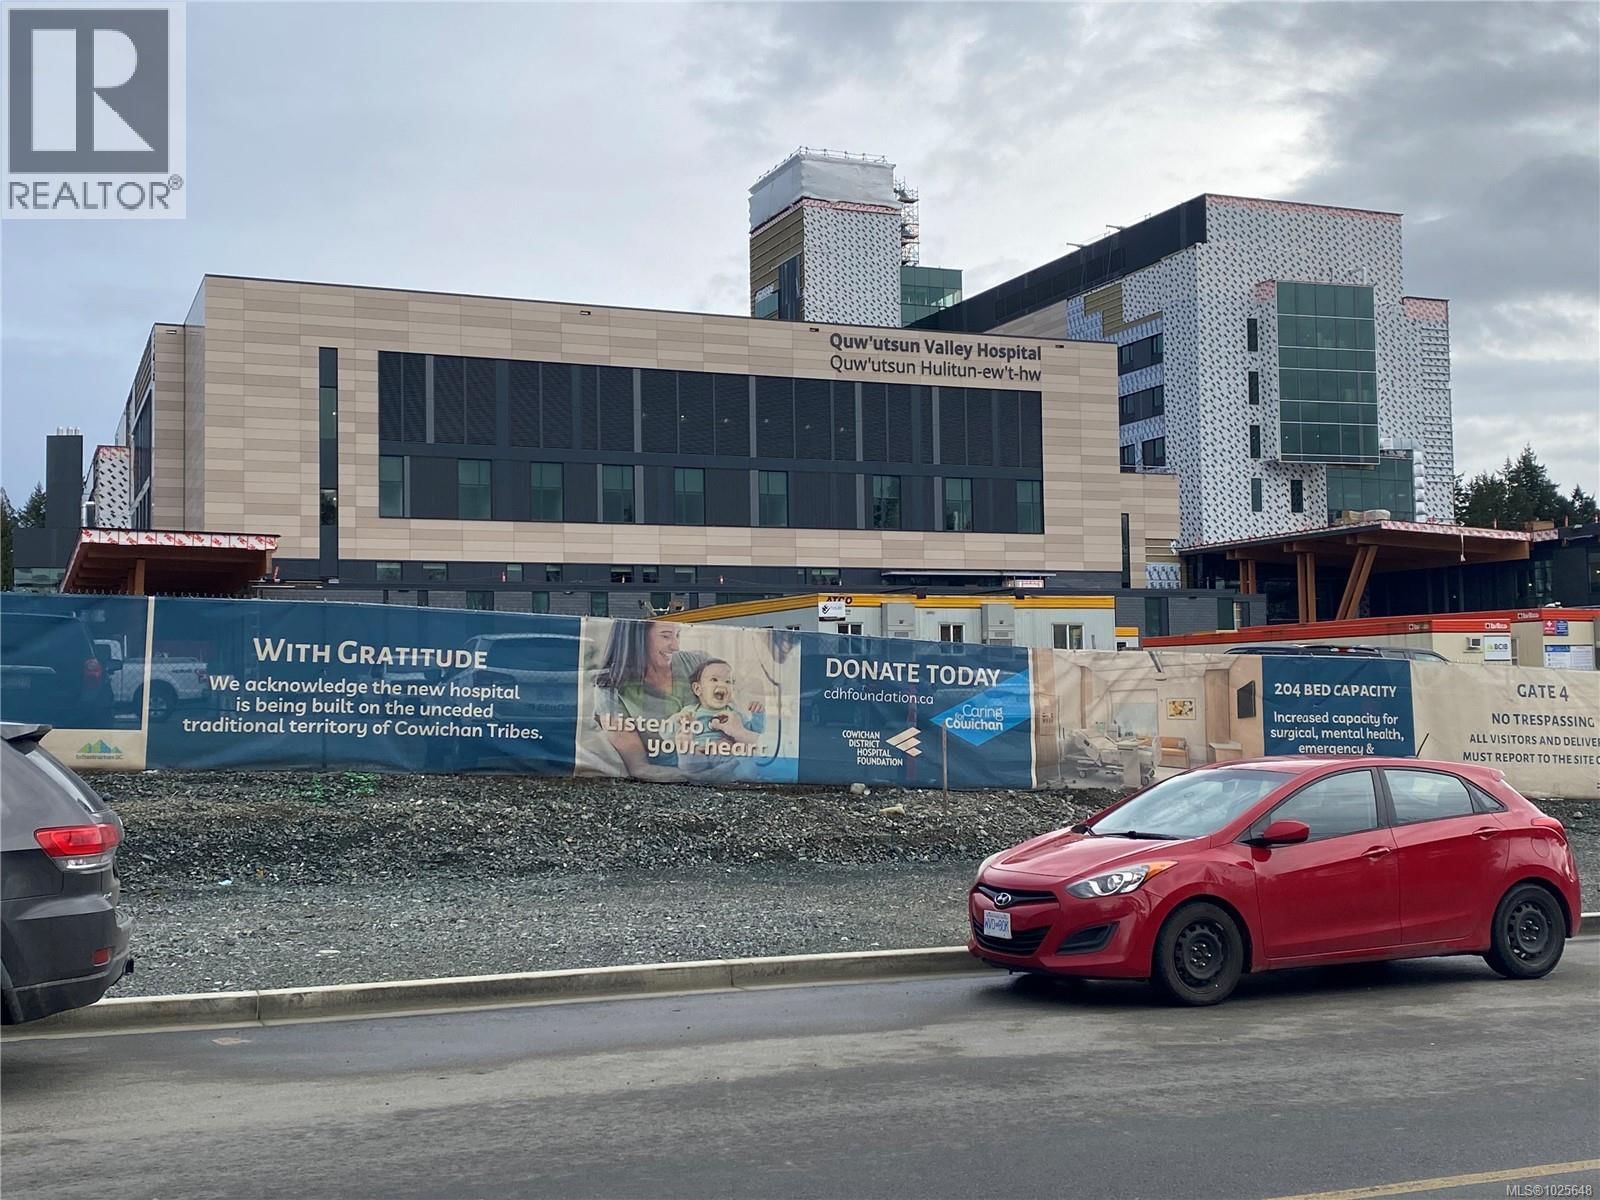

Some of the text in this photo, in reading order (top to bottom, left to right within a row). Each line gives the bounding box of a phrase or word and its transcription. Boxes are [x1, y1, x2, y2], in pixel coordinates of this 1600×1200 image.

[829, 332, 1042, 363] Quw'utsun Valley Hospital
[830, 354, 1042, 382] Quw'utsun Hulitun-ew't-hw
[825, 657, 1001, 688] DONATE TODAY
[209, 674, 520, 701] We acknowledge the new hospital
[1274, 682, 1398, 698] 204 BED CAPACITY
[1516, 684, 1569, 702] GATE 4
[823, 686, 935, 706] cdhfoundation.ca
[235, 696, 495, 719] is being built on the unceded
[962, 704, 1004, 722] Caring
[604, 712, 704, 735] Listen to
[945, 716, 1004, 732] Cowichan
[1273, 711, 1399, 727] Increased capacity for
[1491, 713, 1596, 728] NO TRESPASSING
[182, 717, 544, 740] traditional territory of Cowichan Tribes.
[842, 729, 881, 740] COWICHAN
[1270, 727, 1405, 742] surgical, mental health,
[647, 737, 769, 758] your heart
[848, 738, 881, 749] DISTRICT
[1469, 733, 1488, 744] ALL
[1490, 733, 1537, 745] VISITORS
[1539, 735, 1562, 746] AND
[856, 747, 892, 758] HOSPITAL
[1298, 743, 1375, 756] emergency &
[856, 756, 903, 767] FOUNDATION
[1462, 751, 1493, 762] MUST
[1495, 752, 1535, 763] REPORT
[1537, 753, 1551, 764] TO
[1552, 754, 1573, 765] THE
[1574, 754, 1595, 765] SITE
